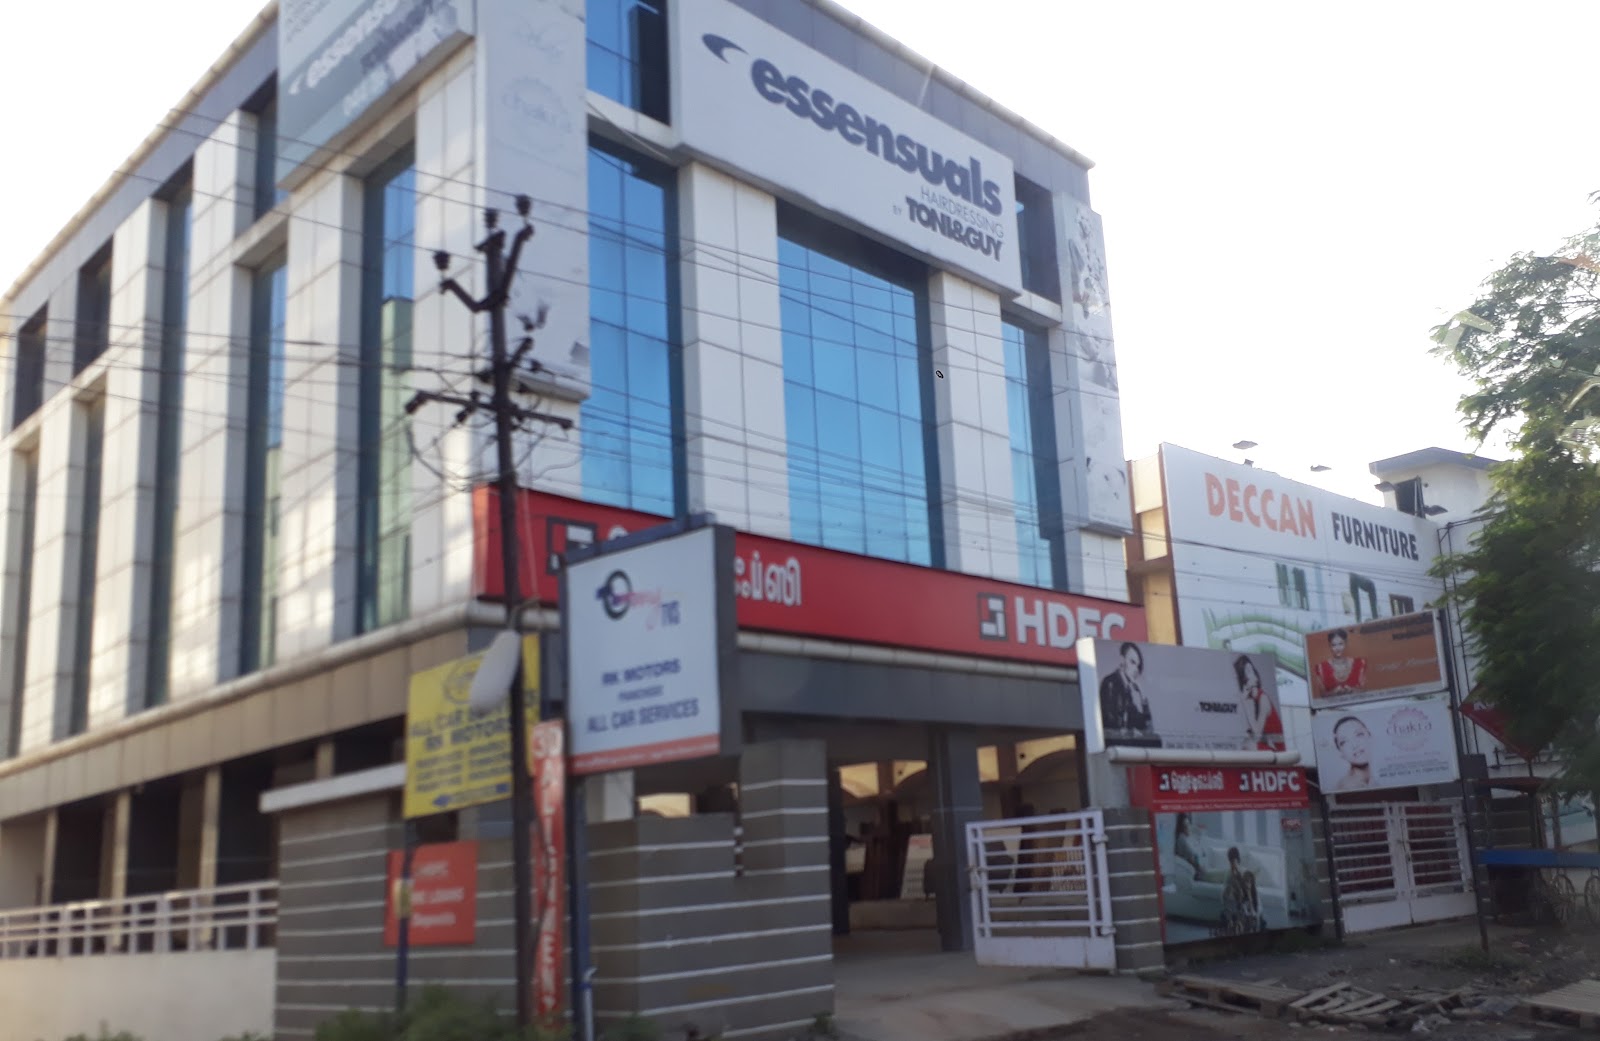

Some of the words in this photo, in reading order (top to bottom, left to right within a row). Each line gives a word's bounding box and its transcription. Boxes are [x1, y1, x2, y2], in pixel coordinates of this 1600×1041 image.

[751, 58, 1002, 216] essensuals
[905, 195, 1004, 262] TONI&GUY
[920, 185, 1004, 239] HAIRDRESSING
[1205, 472, 1317, 540] DECCAN
[1331, 511, 1420, 561] FURNITURE
[1015, 596, 1126, 650] HDFC
[611, 709, 636, 730] CAR
[638, 697, 700, 726] SERVICES
[1250, 770, 1302, 793] HDFC
